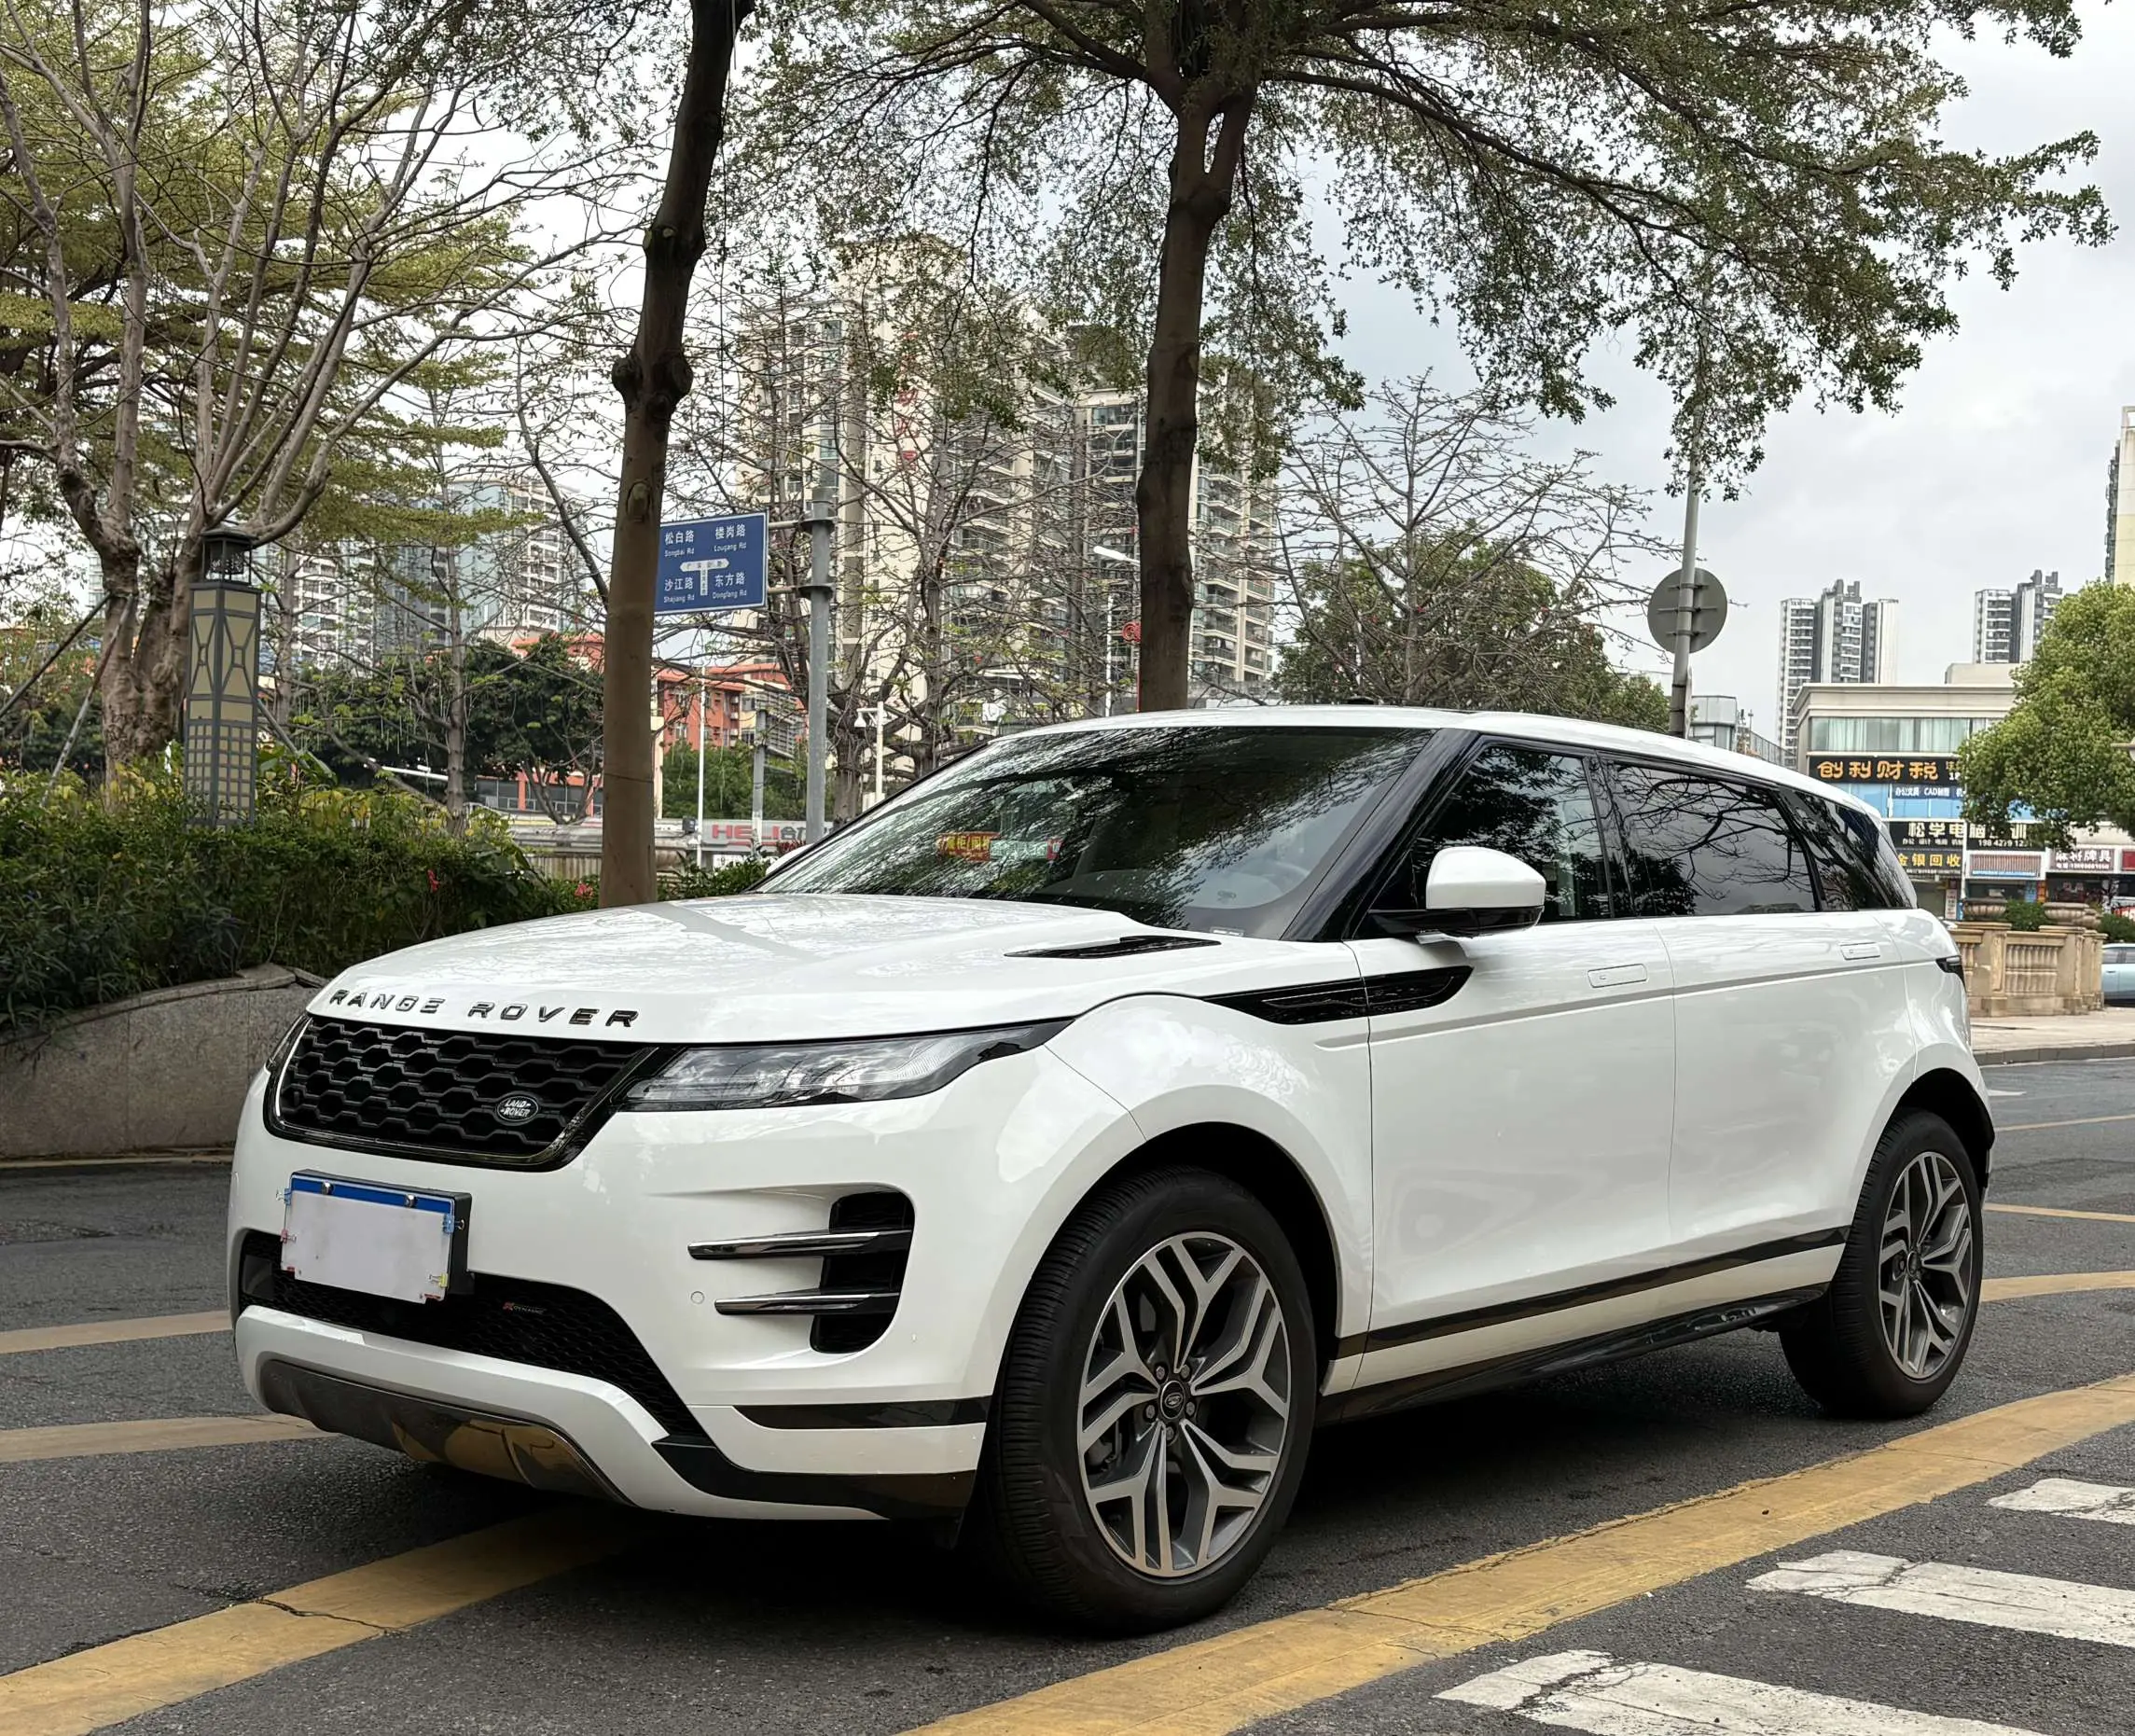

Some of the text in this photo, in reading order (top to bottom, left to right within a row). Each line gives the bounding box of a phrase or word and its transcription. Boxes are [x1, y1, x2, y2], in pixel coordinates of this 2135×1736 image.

[665, 530, 694, 545] 松白路
[715, 524, 745, 539] 楼岗路
[664, 576, 693, 590] 沙江路
[714, 572, 745, 587] 东方路
[1817, 760, 1939, 780] 创利财税
[1897, 853, 1962, 868] 金银回收
[329, 989, 639, 1027] RANGE ROVER
[505, 1099, 528, 1108] LAND
[504, 1107, 531, 1117] ROVER
